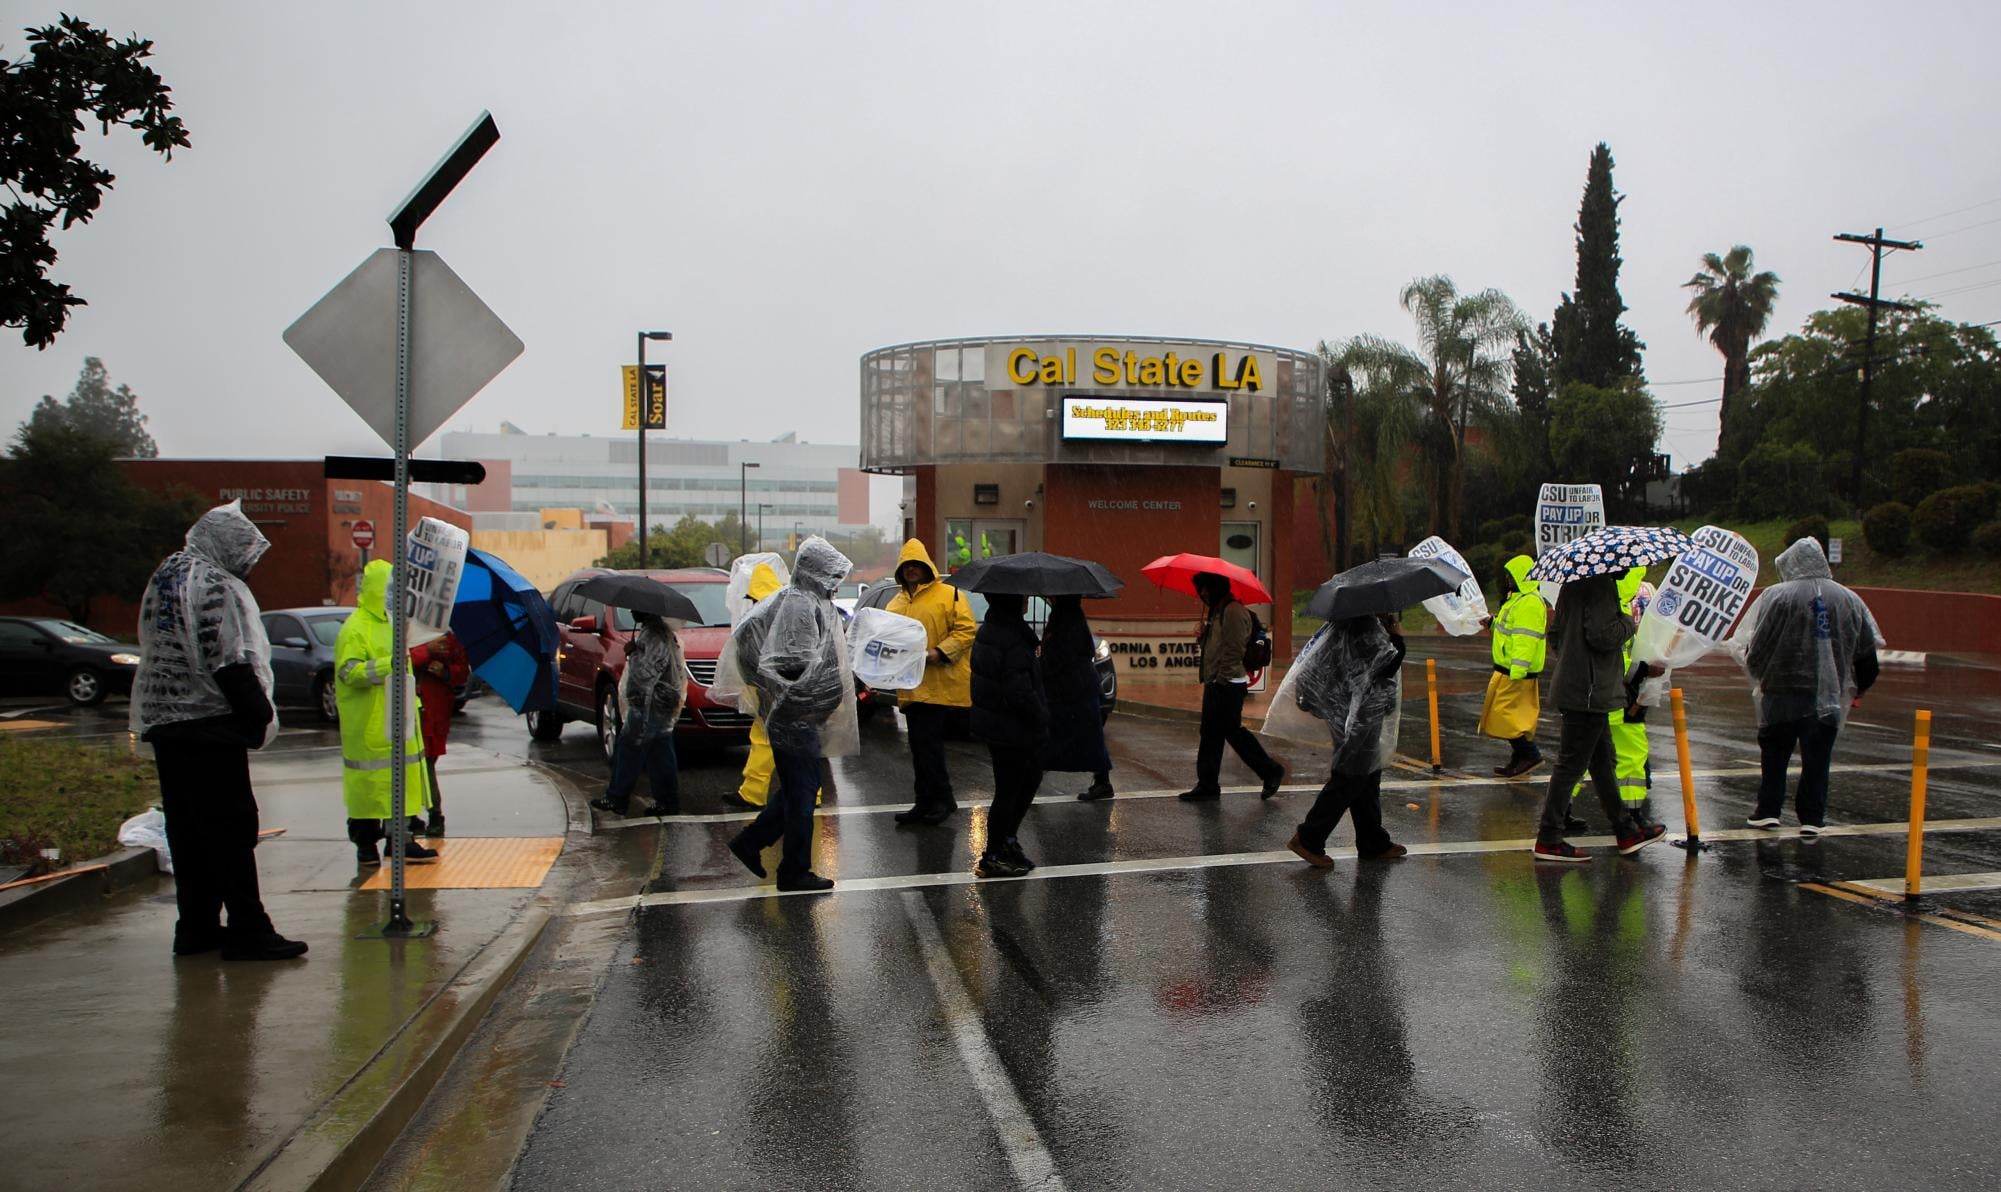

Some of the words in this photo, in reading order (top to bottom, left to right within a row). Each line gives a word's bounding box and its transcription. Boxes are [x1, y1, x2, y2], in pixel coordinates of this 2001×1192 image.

[1007, 347, 1076, 386] Cal
[1092, 347, 1204, 387] State
[1213, 352, 1263, 391] LA
[648, 382, 663, 424] Soar
[1072, 405, 1141, 420] Schedules
[1144, 408, 1166, 420] and
[1170, 408, 1217, 422] Routes
[1105, 418, 1127, 430] 323
[220, 488, 264, 500] PUBLIC
[265, 489, 311, 500] SAFETY
[1542, 486, 1567, 502] CSU
[242, 502, 274, 512] ERSITY
[278, 502, 310, 513] POLICE
[1088, 500, 1138, 510] WELCOME
[1142, 501, 1182, 510] CENTER
[1542, 506, 1563, 521] PAY
[1566, 508, 1582, 522] UP
[1584, 511, 1600, 523] OR
[1694, 527, 1734, 554] CSU
[1728, 550, 1739, 560] TO
[1684, 548, 1714, 571] PAY
[1713, 561, 1736, 581] UP
[1730, 576, 1750, 595] OR
[1669, 564, 1743, 617] STRIKE
[1678, 600, 1732, 641] OUT
[1109, 642, 1152, 654] ORNIA
[1158, 642, 1199, 654] STATE
[1130, 656, 1158, 668] LOS
[1164, 657, 1201, 668] ANGE
